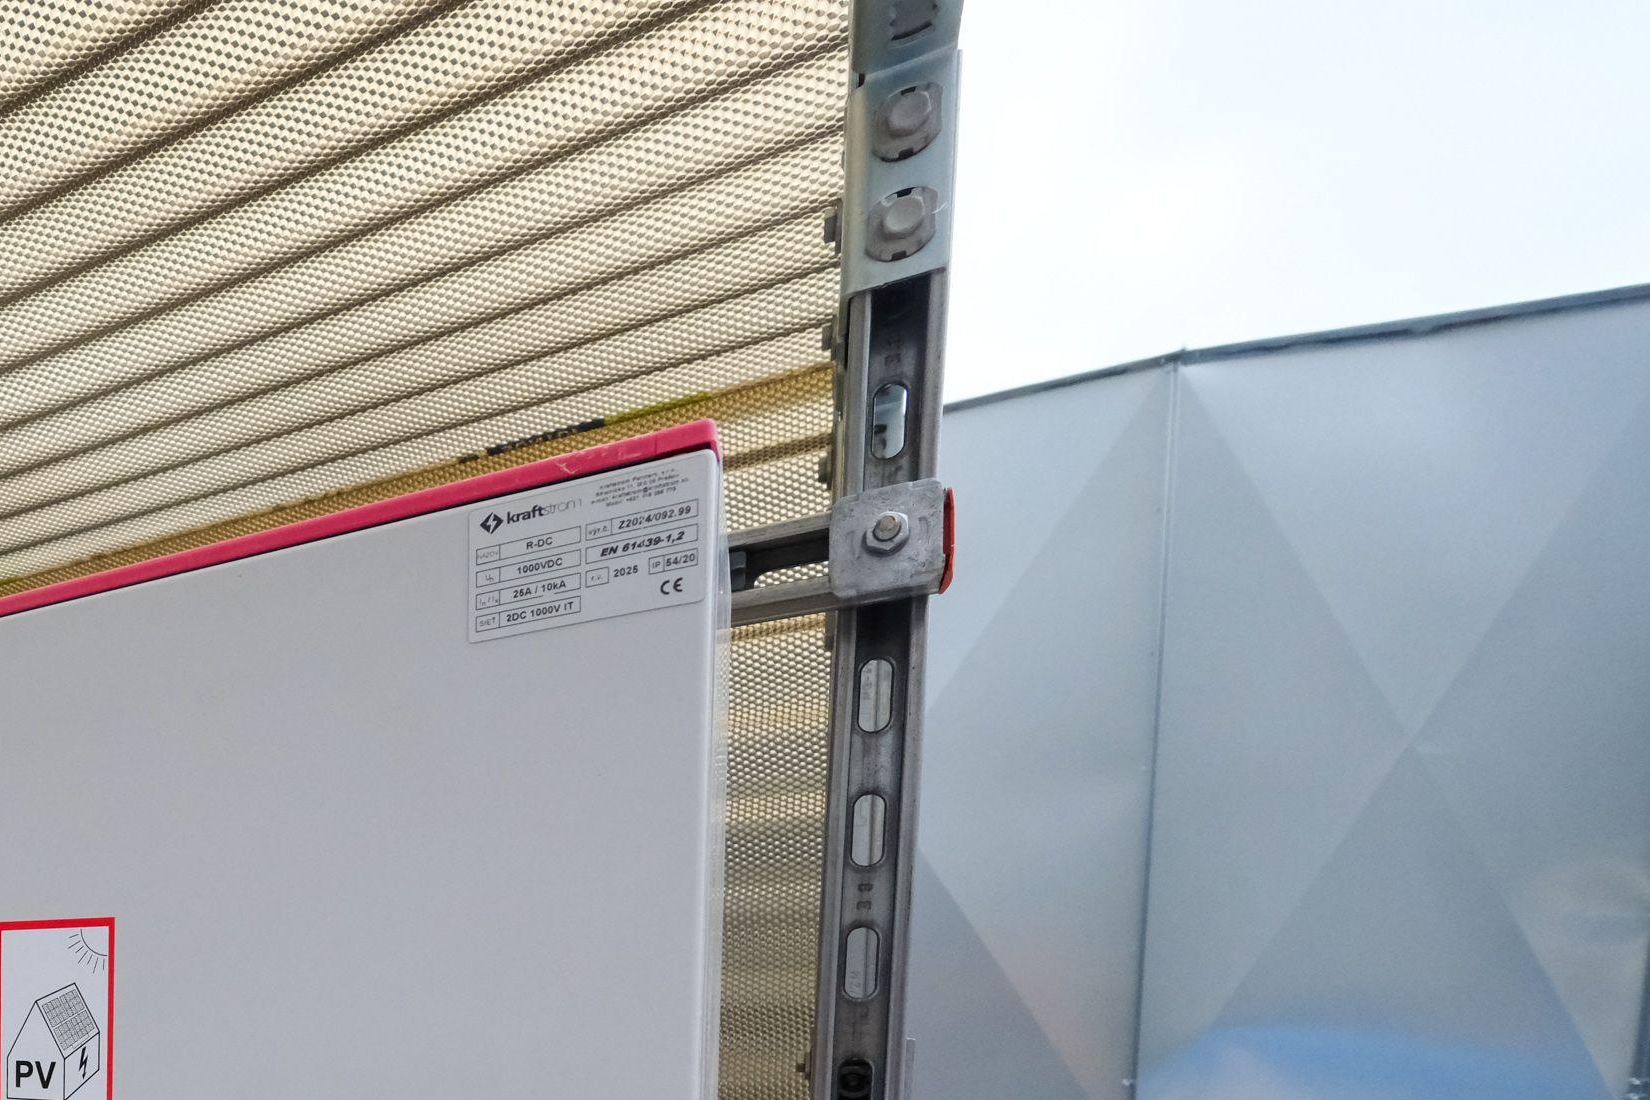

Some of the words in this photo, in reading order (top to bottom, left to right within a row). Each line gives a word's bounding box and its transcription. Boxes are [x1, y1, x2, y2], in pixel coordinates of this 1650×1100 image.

[526, 537, 553, 550] R-DC
[600, 545, 619, 557] EN
[622, 531, 685, 552] 61439-1,2
[517, 557, 563, 574] 1000VDC
[665, 553, 696, 567] 54/20
[613, 565, 638, 578] 2025
[513, 587, 532, 599] 25A
[541, 580, 567, 592] 10kA
[506, 611, 527, 622] 2DC
[530, 604, 561, 617] 1000V
[563, 601, 574, 611] IT
[15, 1060, 57, 1089] PV
